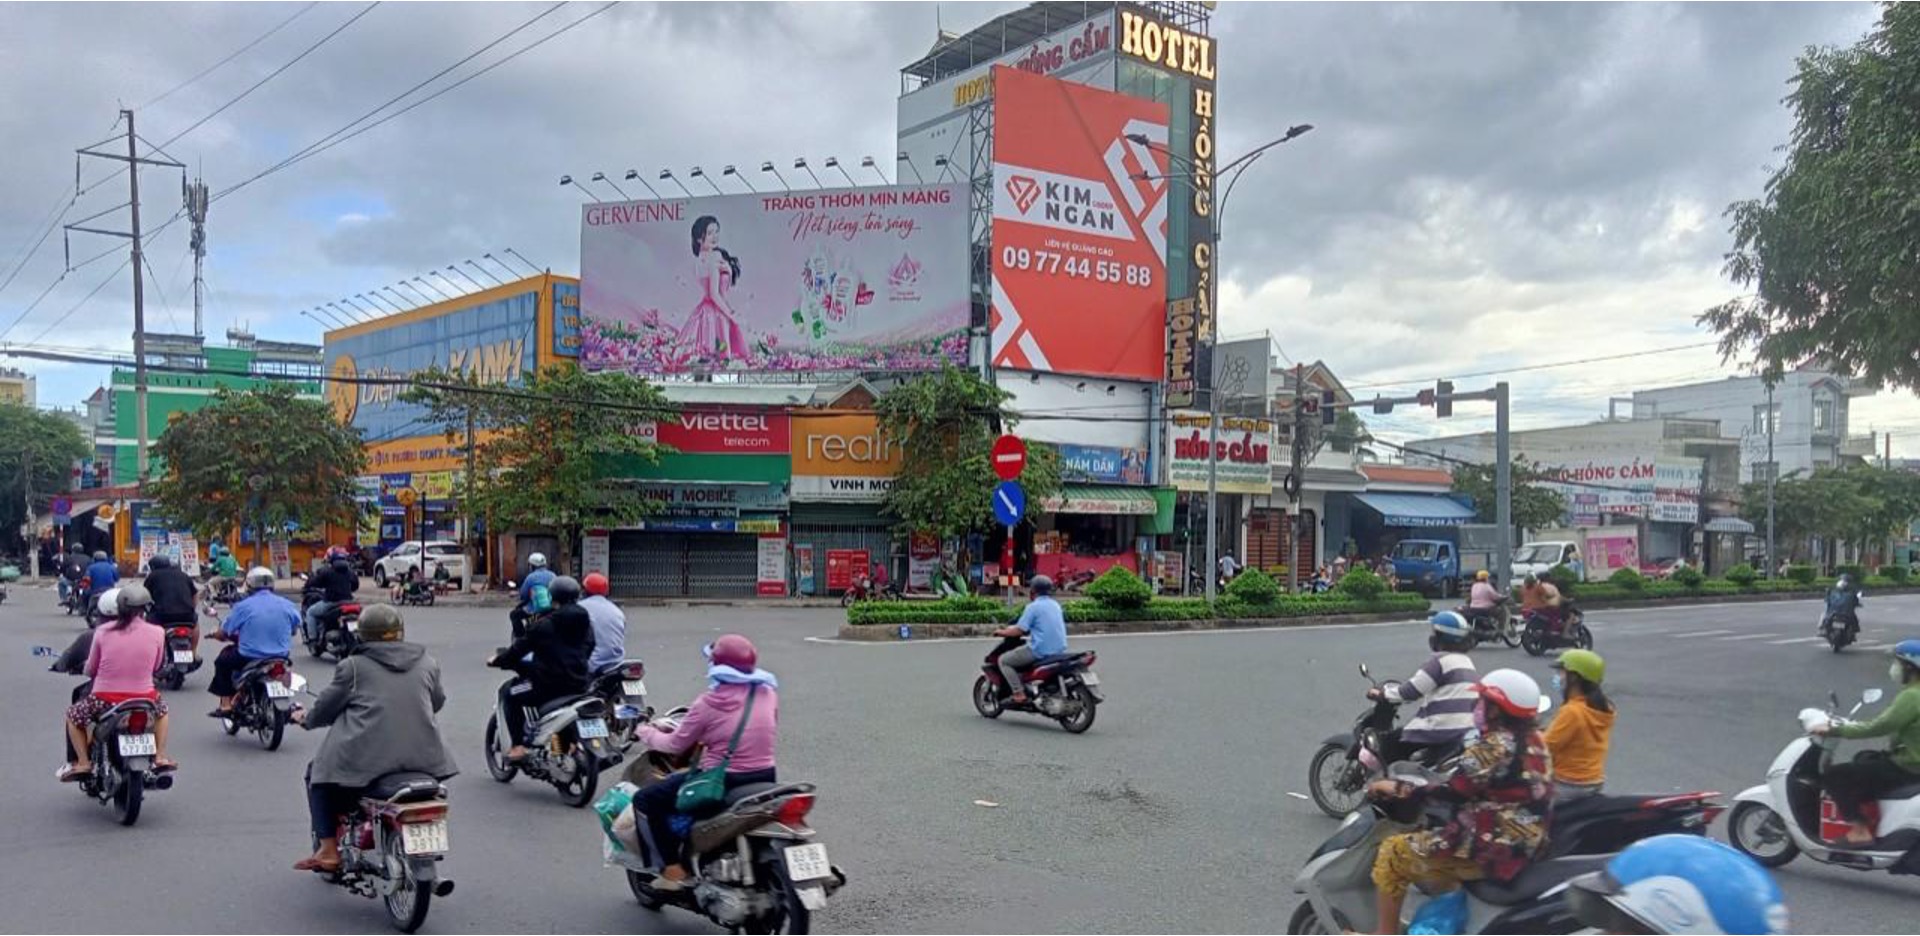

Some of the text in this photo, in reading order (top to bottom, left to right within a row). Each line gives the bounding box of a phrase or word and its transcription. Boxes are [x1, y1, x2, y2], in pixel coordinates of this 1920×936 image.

[1122, 11, 1214, 80] HOTEL
[1045, 182, 1091, 206] KIM
[586, 202, 684, 226] GERVENNE
[1045, 202, 1114, 231] NGAN
[1002, 246, 1151, 287] 09 77 44 55 88
[680, 410, 769, 431] viettel
[724, 435, 770, 447] telecom
[682, 488, 737, 502] MOBILE
[830, 480, 864, 491] VINH
